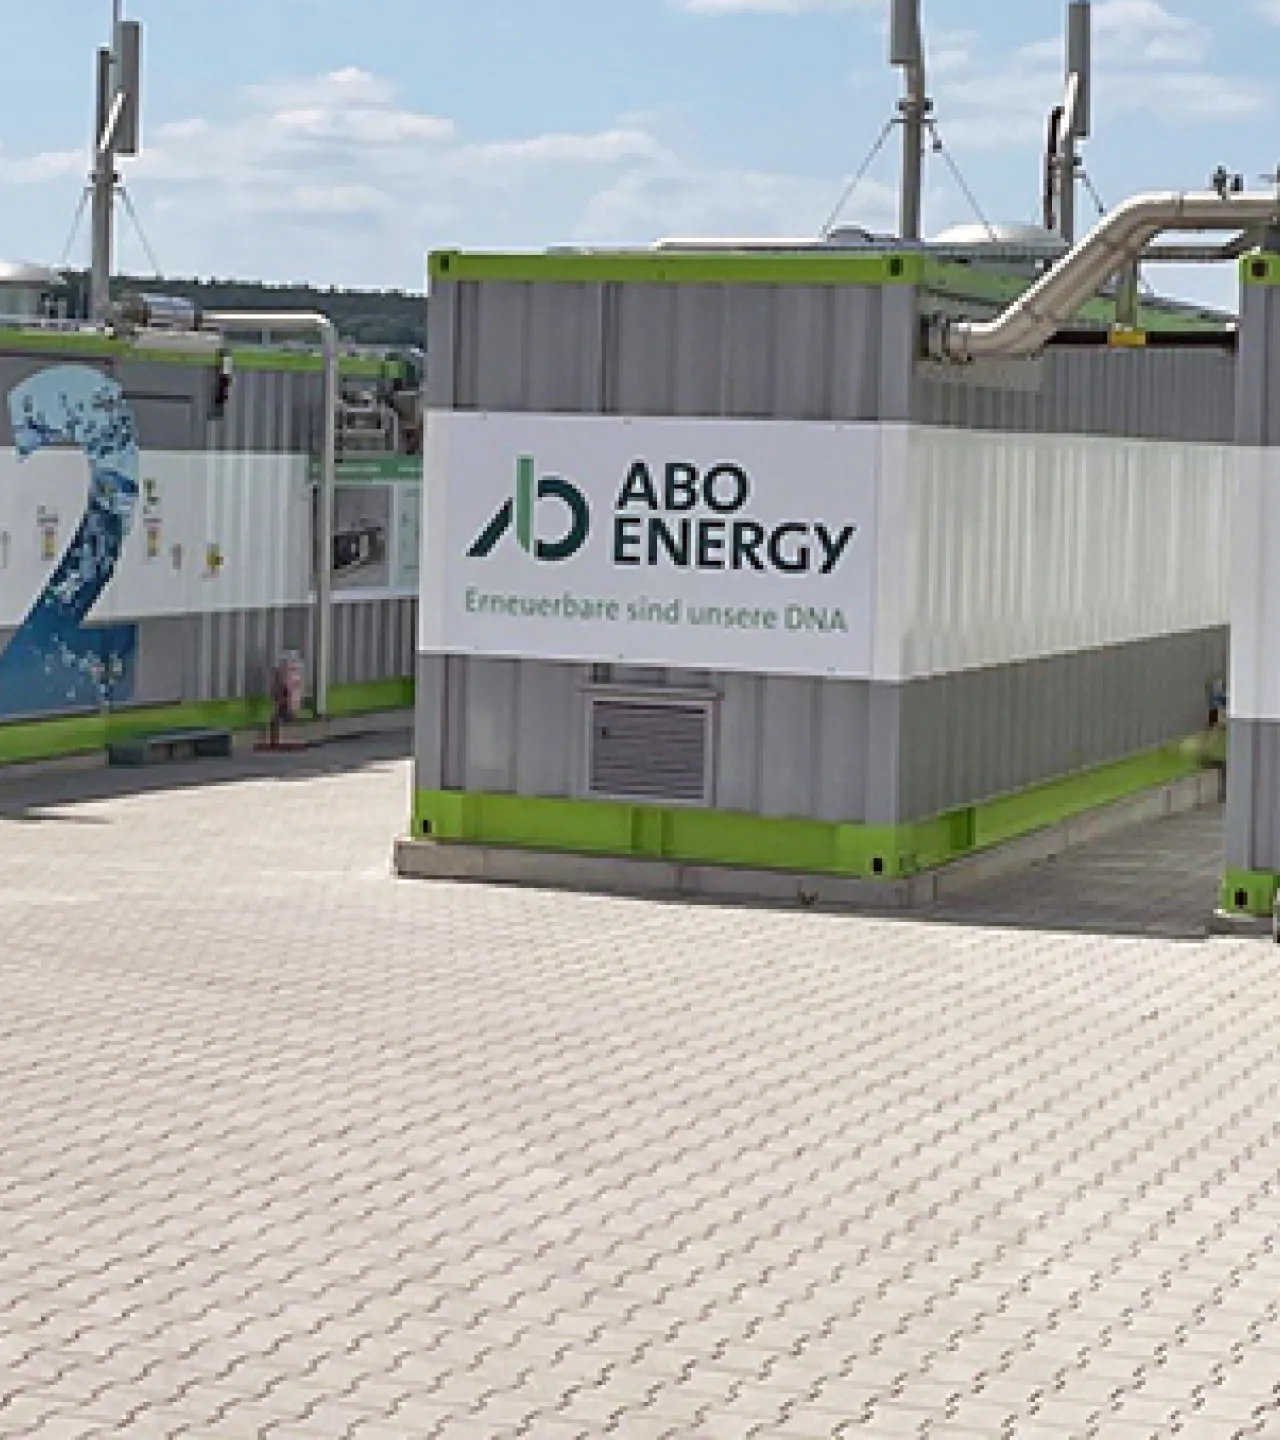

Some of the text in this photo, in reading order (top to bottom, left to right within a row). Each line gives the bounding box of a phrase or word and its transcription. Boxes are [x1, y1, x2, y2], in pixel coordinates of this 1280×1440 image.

[616, 460, 750, 513] ABO
[614, 517, 856, 574] ENERGY
[464, 587, 849, 633] Erneuerbare sind unsere DNA
